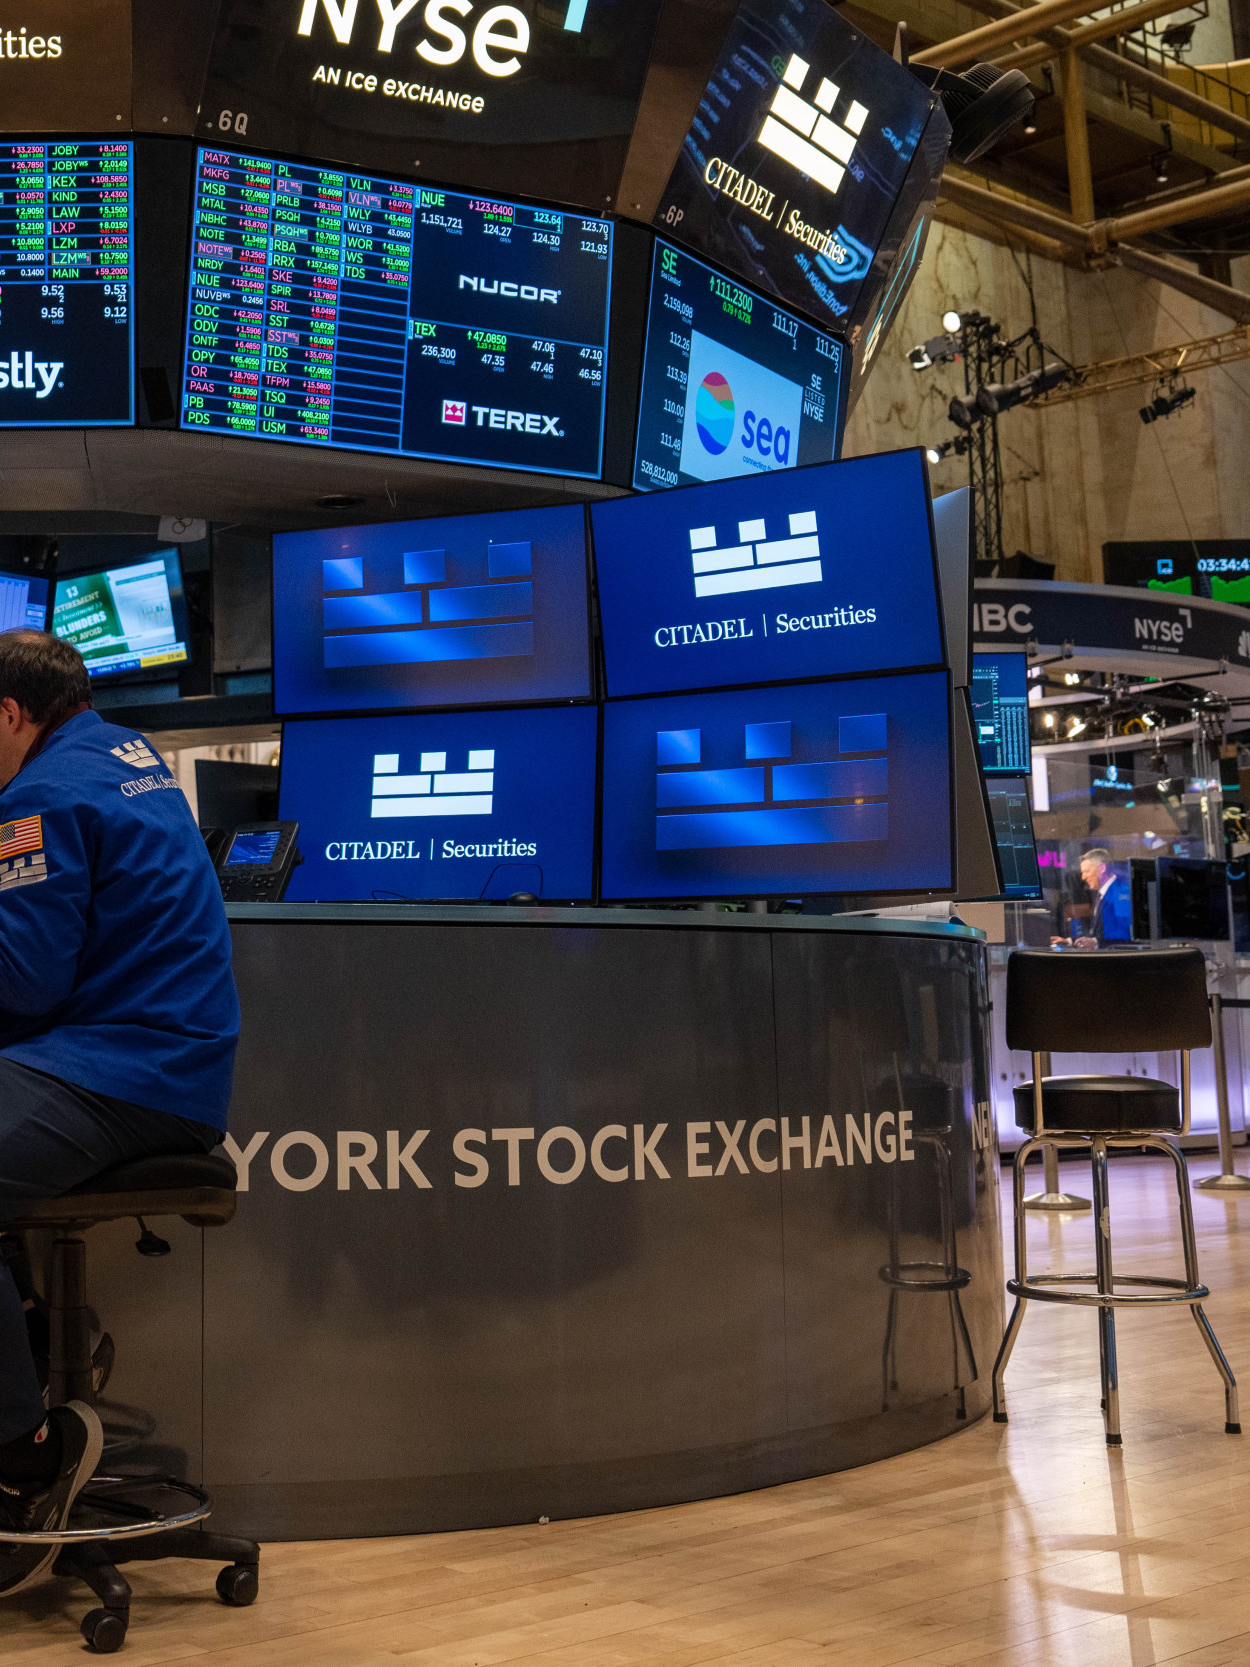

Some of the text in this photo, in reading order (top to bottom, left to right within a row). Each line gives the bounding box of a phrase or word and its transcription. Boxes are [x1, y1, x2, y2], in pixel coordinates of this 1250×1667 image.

[313, 65, 339, 85] AN
[383, 78, 484, 113] EXCHANGE
[219, 109, 248, 135] 6Q
[52, 146, 79, 155] JOBY
[204, 153, 230, 165] MATX
[52, 177, 76, 187] KEX
[52, 192, 77, 201] KIND
[52, 207, 80, 217] LAW
[421, 191, 609, 234] NUE 123.6400 123.64 123.70
[666, 206, 683, 226] 6P
[704, 157, 848, 264] CITADEL Securities
[421, 212, 608, 254] 1,151,721 124.27 124.30 121.93
[41, 285, 64, 296] 9.52
[104, 285, 126, 295] 9.53
[197, 274, 220, 286] NUE
[41, 308, 64, 318] 9.56
[104, 307, 126, 317] 9.12
[661, 249, 840, 362] SE 111.2300 111.17 111.25
[415, 322, 602, 360] TEX 47.0850 47.06 47.10
[267, 360, 287, 372] TEX
[421, 345, 601, 381] 236,300 47.35 47.46 46.56
[811, 374, 822, 389] SE
[805, 390, 826, 405] LISTED
[472, 406, 560, 436] TEREX
[803, 402, 824, 423] NYSE
[741, 410, 791, 465] sea
[1197, 558, 1250, 572] 03:34:4
[66, 586, 79, 598] 13
[56, 610, 107, 637] BLUNDERS
[80, 627, 102, 641] AVOID
[654, 605, 877, 647] CITADEL Securities
[120, 775, 159, 797] CITADEL
[325, 838, 537, 861] CITADEL Securities
[228, 1110, 915, 1192] YORK STOCK EXCHANGE
